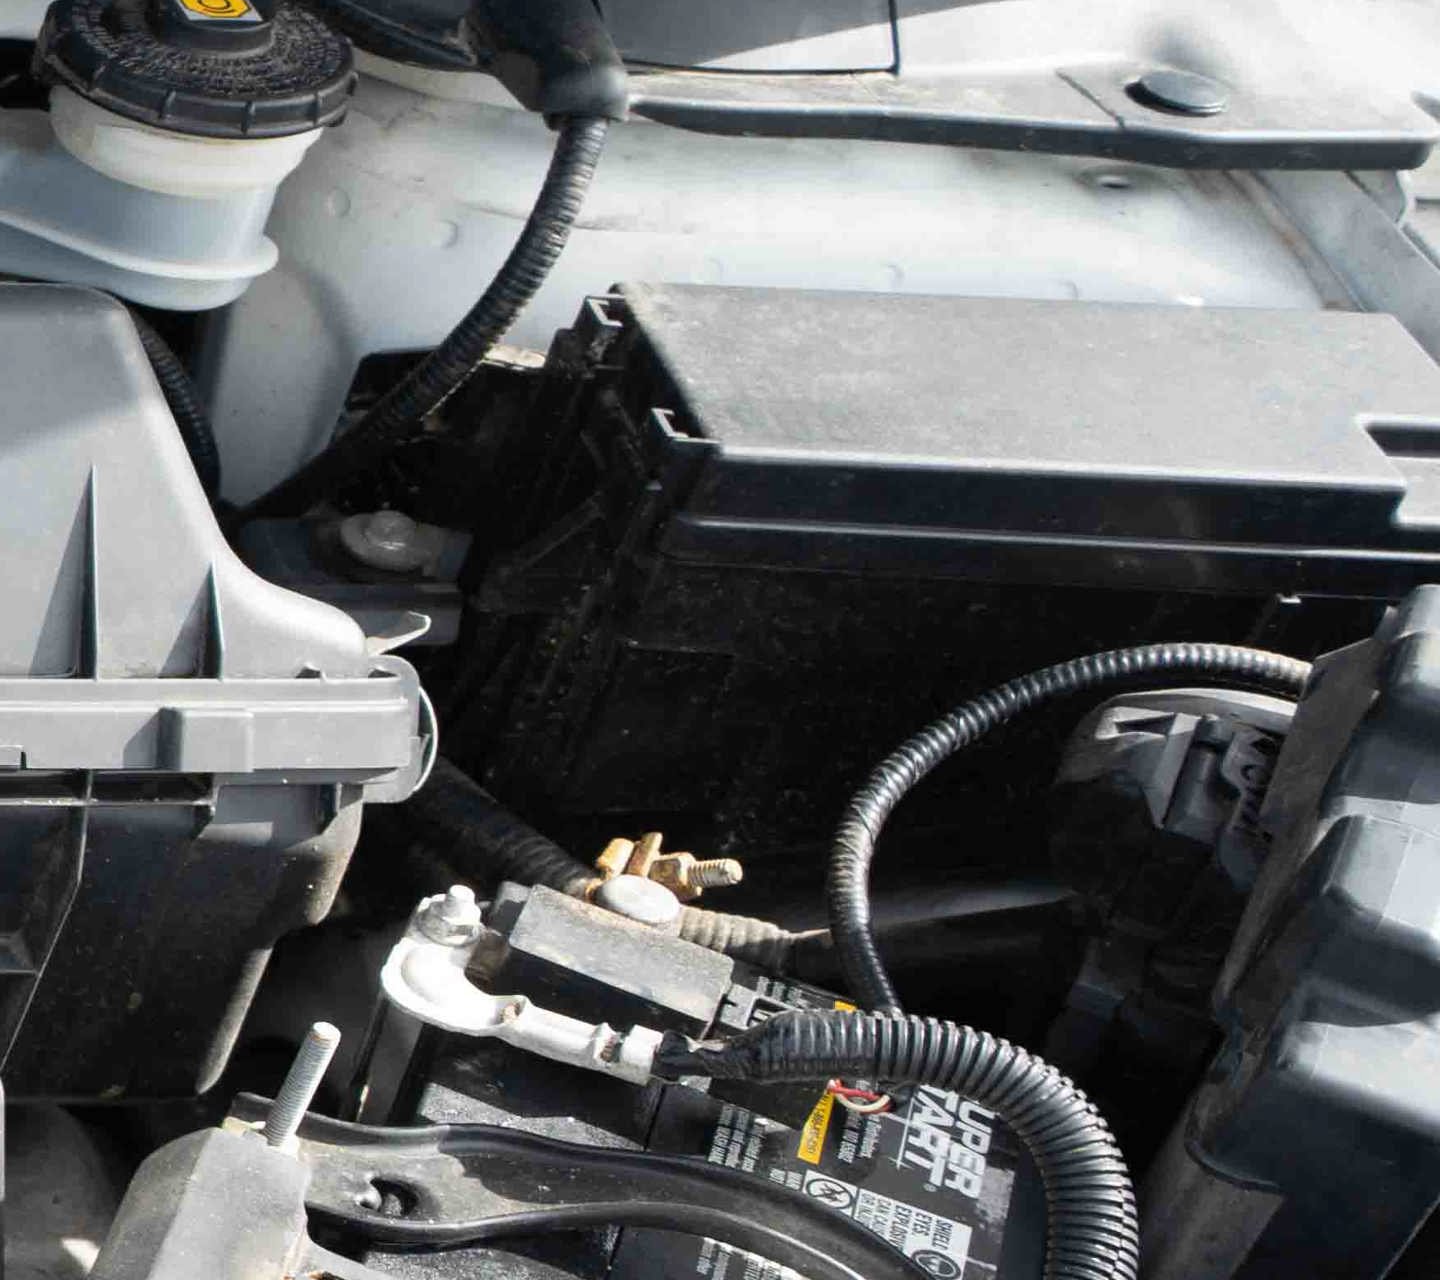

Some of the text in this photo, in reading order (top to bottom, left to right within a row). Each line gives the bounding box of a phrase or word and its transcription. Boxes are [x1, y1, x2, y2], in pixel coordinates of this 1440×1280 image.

[905, 1084, 958, 1187] TART
[950, 1099, 997, 1199] UPER
[934, 1219, 953, 1252] SHIELD
